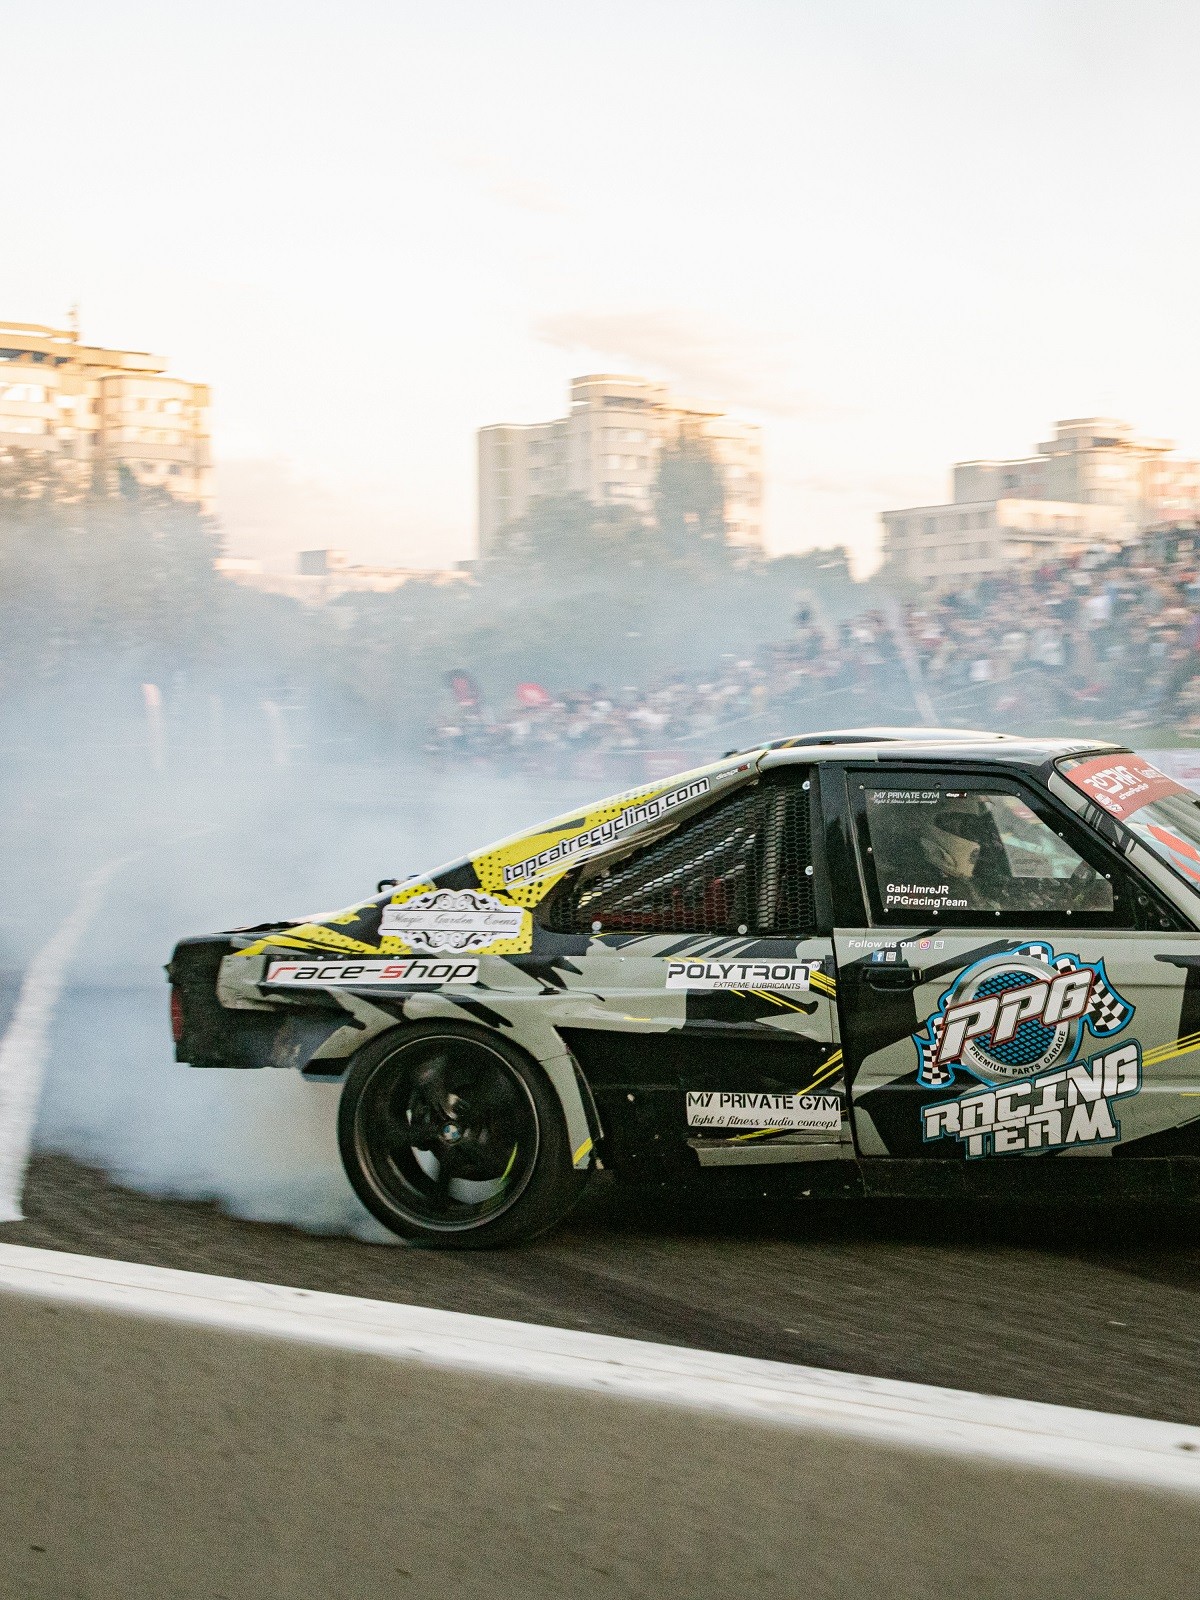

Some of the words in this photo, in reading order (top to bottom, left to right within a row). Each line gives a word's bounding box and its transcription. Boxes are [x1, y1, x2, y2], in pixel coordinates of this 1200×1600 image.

[887, 791, 920, 799] PRIVATE
[504, 777, 710, 883] topcatrecycling.com
[886, 883, 949, 894] Gabi.ImreJR
[886, 895, 968, 908] PPGracingTeam
[431, 913, 474, 927] Garden
[483, 915, 518, 926] Events
[848, 940, 881, 948] Follow
[900, 940, 916, 948] on:
[267, 961, 478, 982] race-shop
[668, 963, 810, 981] POLYTRON
[713, 981, 750, 989] EXTREME
[751, 982, 801, 990] LUBRICANTS
[935, 968, 1094, 1066] PPG
[968, 1045, 1008, 1074] PREMIUM
[1011, 1063, 1042, 1075] PARTS
[1043, 1030, 1067, 1064] GARAGE
[923, 1043, 1140, 1138] RACING
[688, 1092, 714, 1108] MY
[719, 1093, 794, 1110] PRIVATE
[799, 1096, 840, 1112] GYM
[691, 1114, 715, 1126] fight
[726, 1116, 760, 1127] fitness
[764, 1117, 794, 1127] studio
[797, 1118, 838, 1129] concept
[959, 1097, 1117, 1157] TEAM
